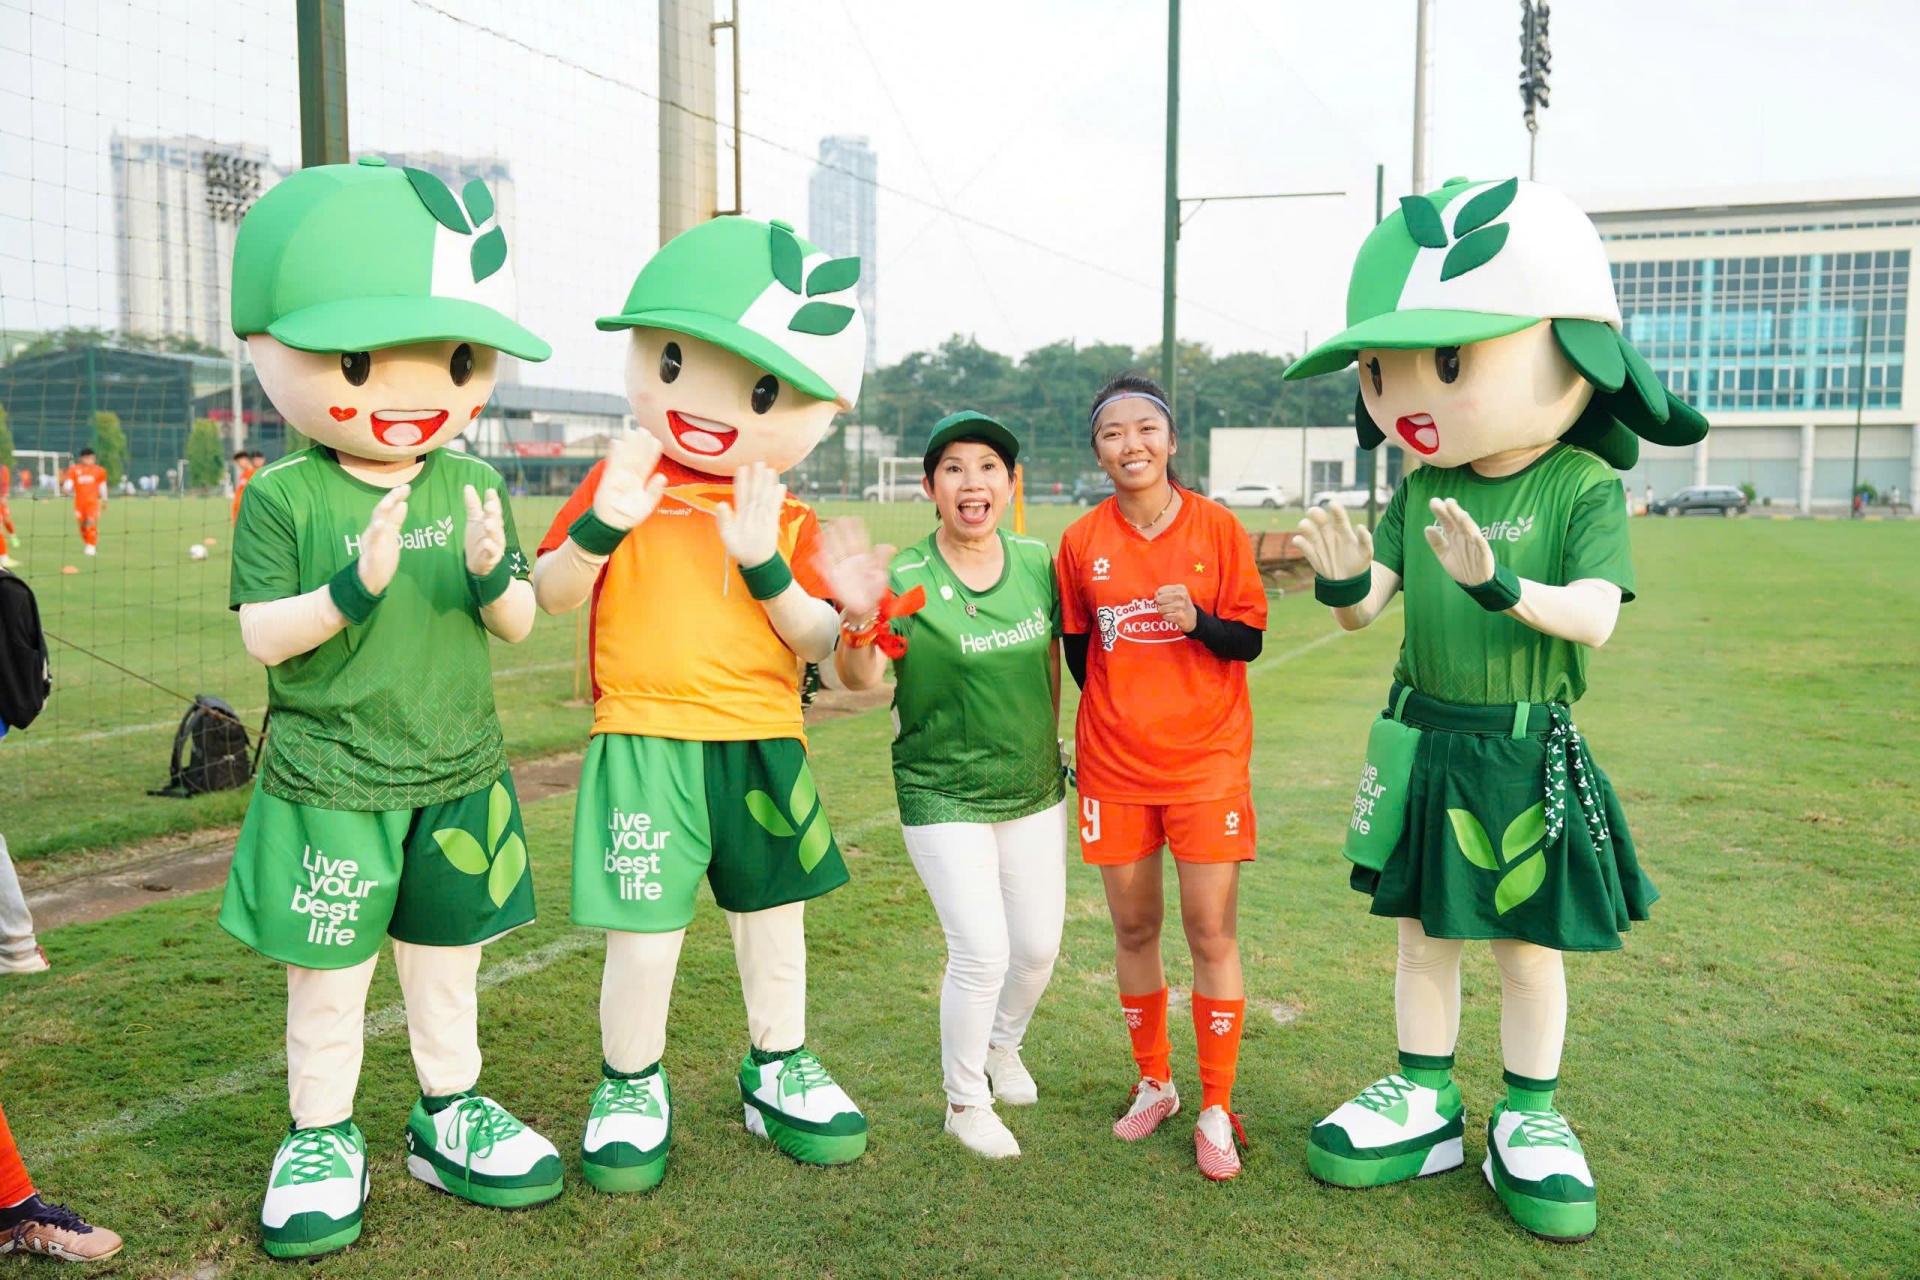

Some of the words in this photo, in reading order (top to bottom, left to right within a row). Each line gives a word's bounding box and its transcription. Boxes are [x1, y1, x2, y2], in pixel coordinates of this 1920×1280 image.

[1116, 601, 1142, 617] Cook
[960, 617, 1045, 655] Herbalife
[1362, 758, 1378, 781] ive
[607, 806, 652, 832] Live
[1354, 794, 1375, 817] est
[1081, 796, 1101, 844] 9
[611, 830, 671, 856] your
[302, 843, 359, 879] Live
[603, 846, 661, 875] best
[307, 871, 379, 898] your
[620, 873, 663, 901] life
[290, 884, 360, 921] best
[307, 918, 356, 946] life
